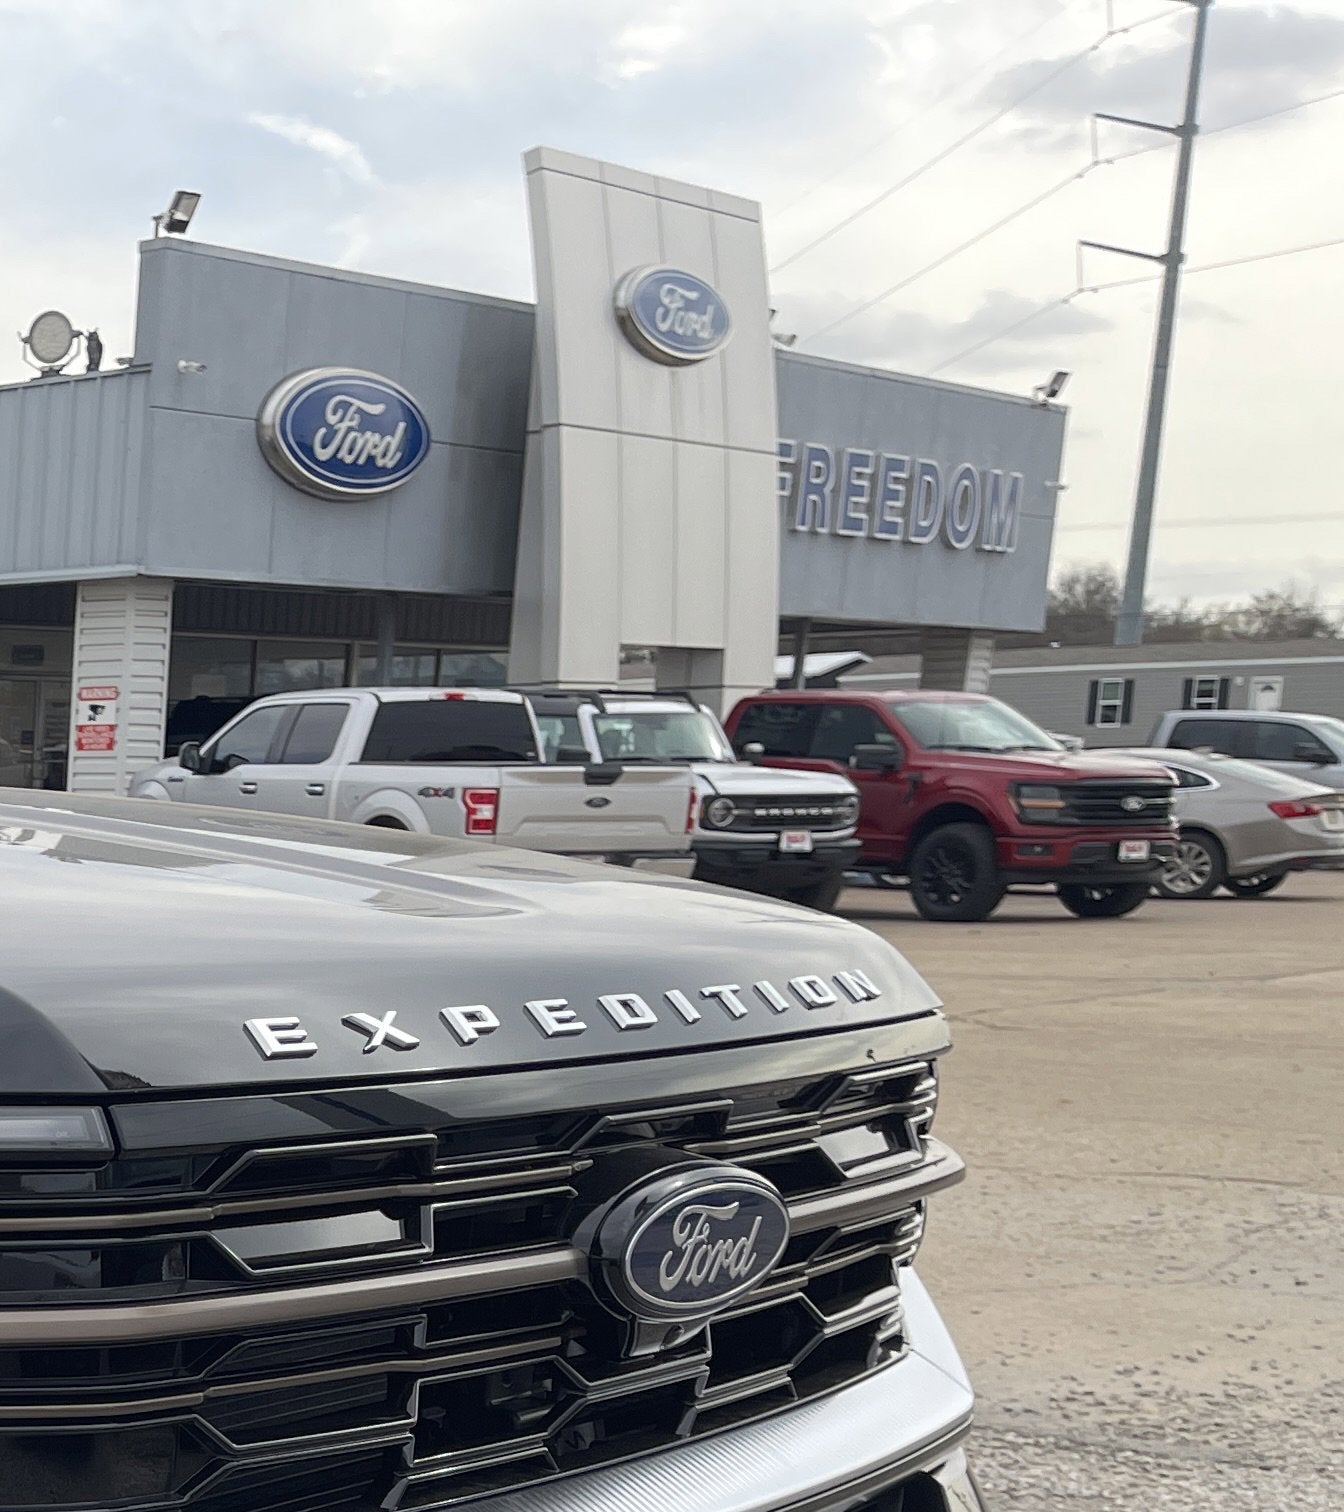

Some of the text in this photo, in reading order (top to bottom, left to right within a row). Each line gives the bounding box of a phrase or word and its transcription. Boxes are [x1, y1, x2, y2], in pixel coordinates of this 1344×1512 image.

[655, 283, 714, 340] Ford
[312, 393, 402, 470] Ford
[242, 968, 883, 1060] EXPEDITION
[659, 1201, 763, 1292] Ford
